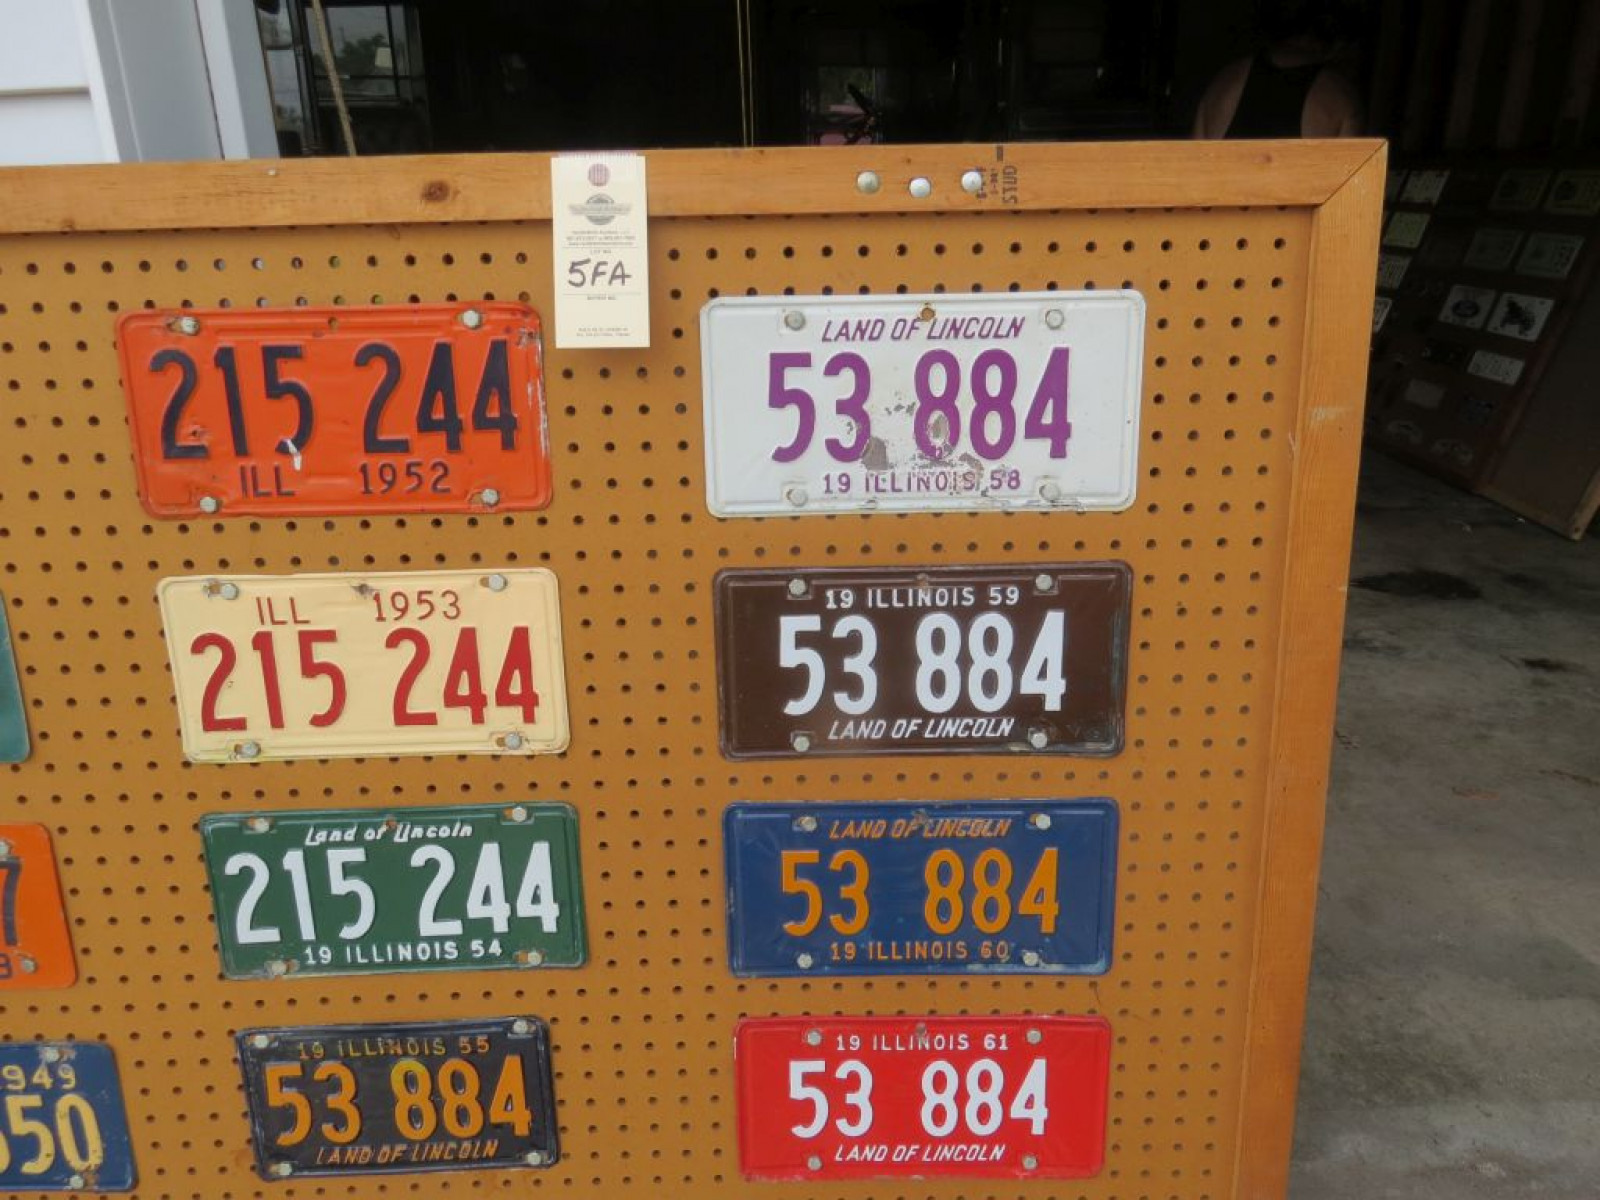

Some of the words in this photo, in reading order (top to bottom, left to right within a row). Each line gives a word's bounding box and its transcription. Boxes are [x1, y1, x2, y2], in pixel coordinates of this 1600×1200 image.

[568, 257, 632, 287] 5FA
[821, 319, 885, 342] LAND
[890, 317, 921, 340] OF
[926, 315, 1026, 340] LINCOLN
[149, 344, 314, 460] 215
[353, 338, 518, 454] 244
[767, 351, 872, 463] 53
[913, 346, 1072, 461] 884
[239, 464, 295, 499] ILL
[359, 460, 452, 495] 1952
[822, 472, 851, 495] 19
[864, 470, 976, 493] ILLINOIS
[989, 469, 1022, 491] 58
[255, 596, 312, 625] ILL
[373, 589, 463, 622] 1953
[825, 589, 854, 609] 19
[867, 587, 976, 609] ILLINOIS
[988, 586, 1020, 606] 59
[778, 613, 878, 715] 53
[915, 609, 1067, 714] 884
[190, 629, 347, 732] 215
[385, 626, 541, 726] 244
[828, 719, 886, 740] LAND
[891, 718, 924, 739] OF
[924, 717, 1015, 739] LINCOLN
[304, 825, 357, 847] Land
[363, 823, 388, 841] of
[393, 821, 473, 843] Lincoln
[829, 819, 888, 839] LAND
[891, 818, 922, 838] OF
[922, 816, 1012, 837] LINCOLN
[224, 847, 376, 945] 215
[410, 841, 560, 937] 244
[780, 847, 870, 936] 53
[923, 846, 1059, 935] 884
[304, 945, 332, 965] 19
[346, 940, 459, 964] ILLINOIS
[471, 938, 503, 958] 54
[830, 942, 857, 961] 19
[868, 940, 968, 960] ILLINOIS
[980, 940, 1009, 959] 60
[298, 1042, 325, 1060] 19
[338, 1036, 447, 1057] ILLINOIS
[459, 1035, 490, 1054] 55
[836, 1034, 861, 1051] 19
[872, 1033, 970, 1051] ILLINOIS
[983, 1033, 1009, 1050] 61
[0, 1064, 76, 1090] 949
[265, 1060, 362, 1146] 53
[390, 1054, 532, 1141] 884
[788, 1058, 874, 1139] 53
[920, 1058, 1048, 1137] 884
[315, 1146, 370, 1165] LAND
[377, 1142, 406, 1162] OF
[409, 1139, 499, 1161] LINCOLN
[834, 1145, 888, 1162] LAND
[891, 1144, 917, 1161] OF
[921, 1144, 1006, 1162] LINCOLN
